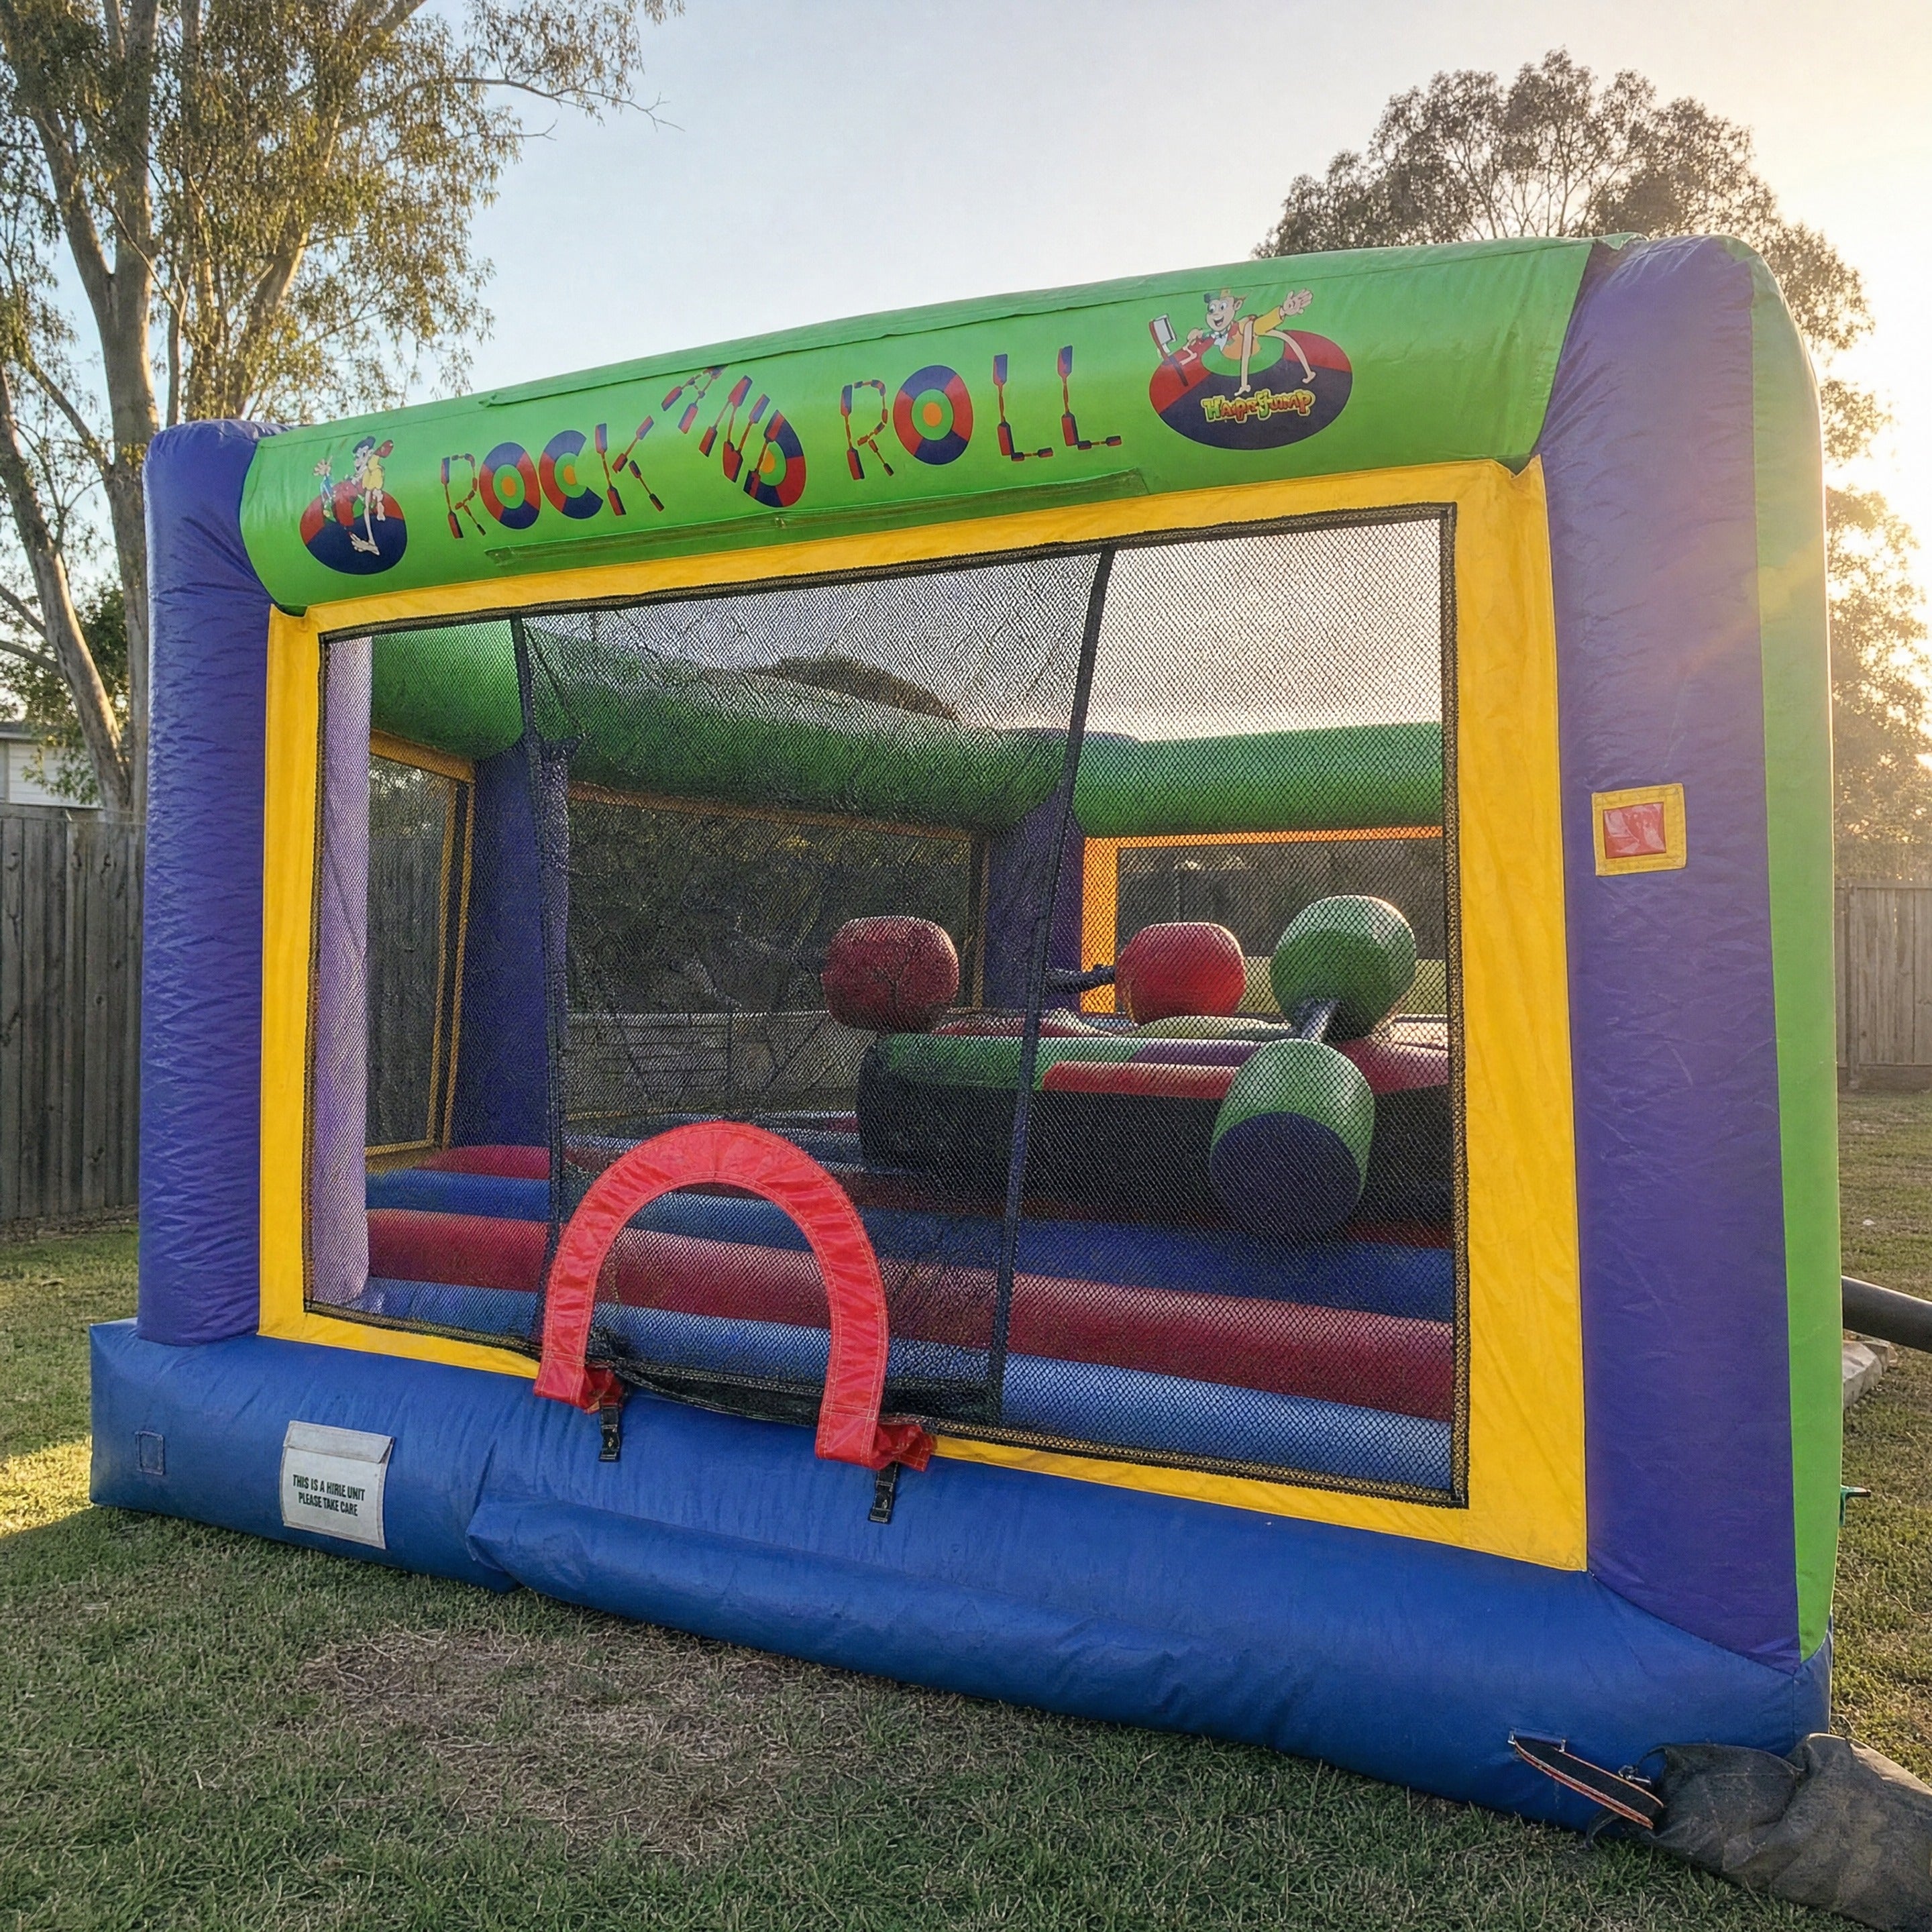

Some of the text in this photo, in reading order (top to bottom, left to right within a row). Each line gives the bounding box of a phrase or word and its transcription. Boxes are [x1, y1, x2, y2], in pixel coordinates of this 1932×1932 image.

[440, 345, 1122, 539] ROCK AND ROLL
[292, 1474, 309, 1489] THIS
[311, 1479, 319, 1491] IS
[319, 1481, 325, 1493] A
[347, 1486, 366, 1501] UNIT
[298, 1492, 358, 1517] PLEASE TAKE CARE
